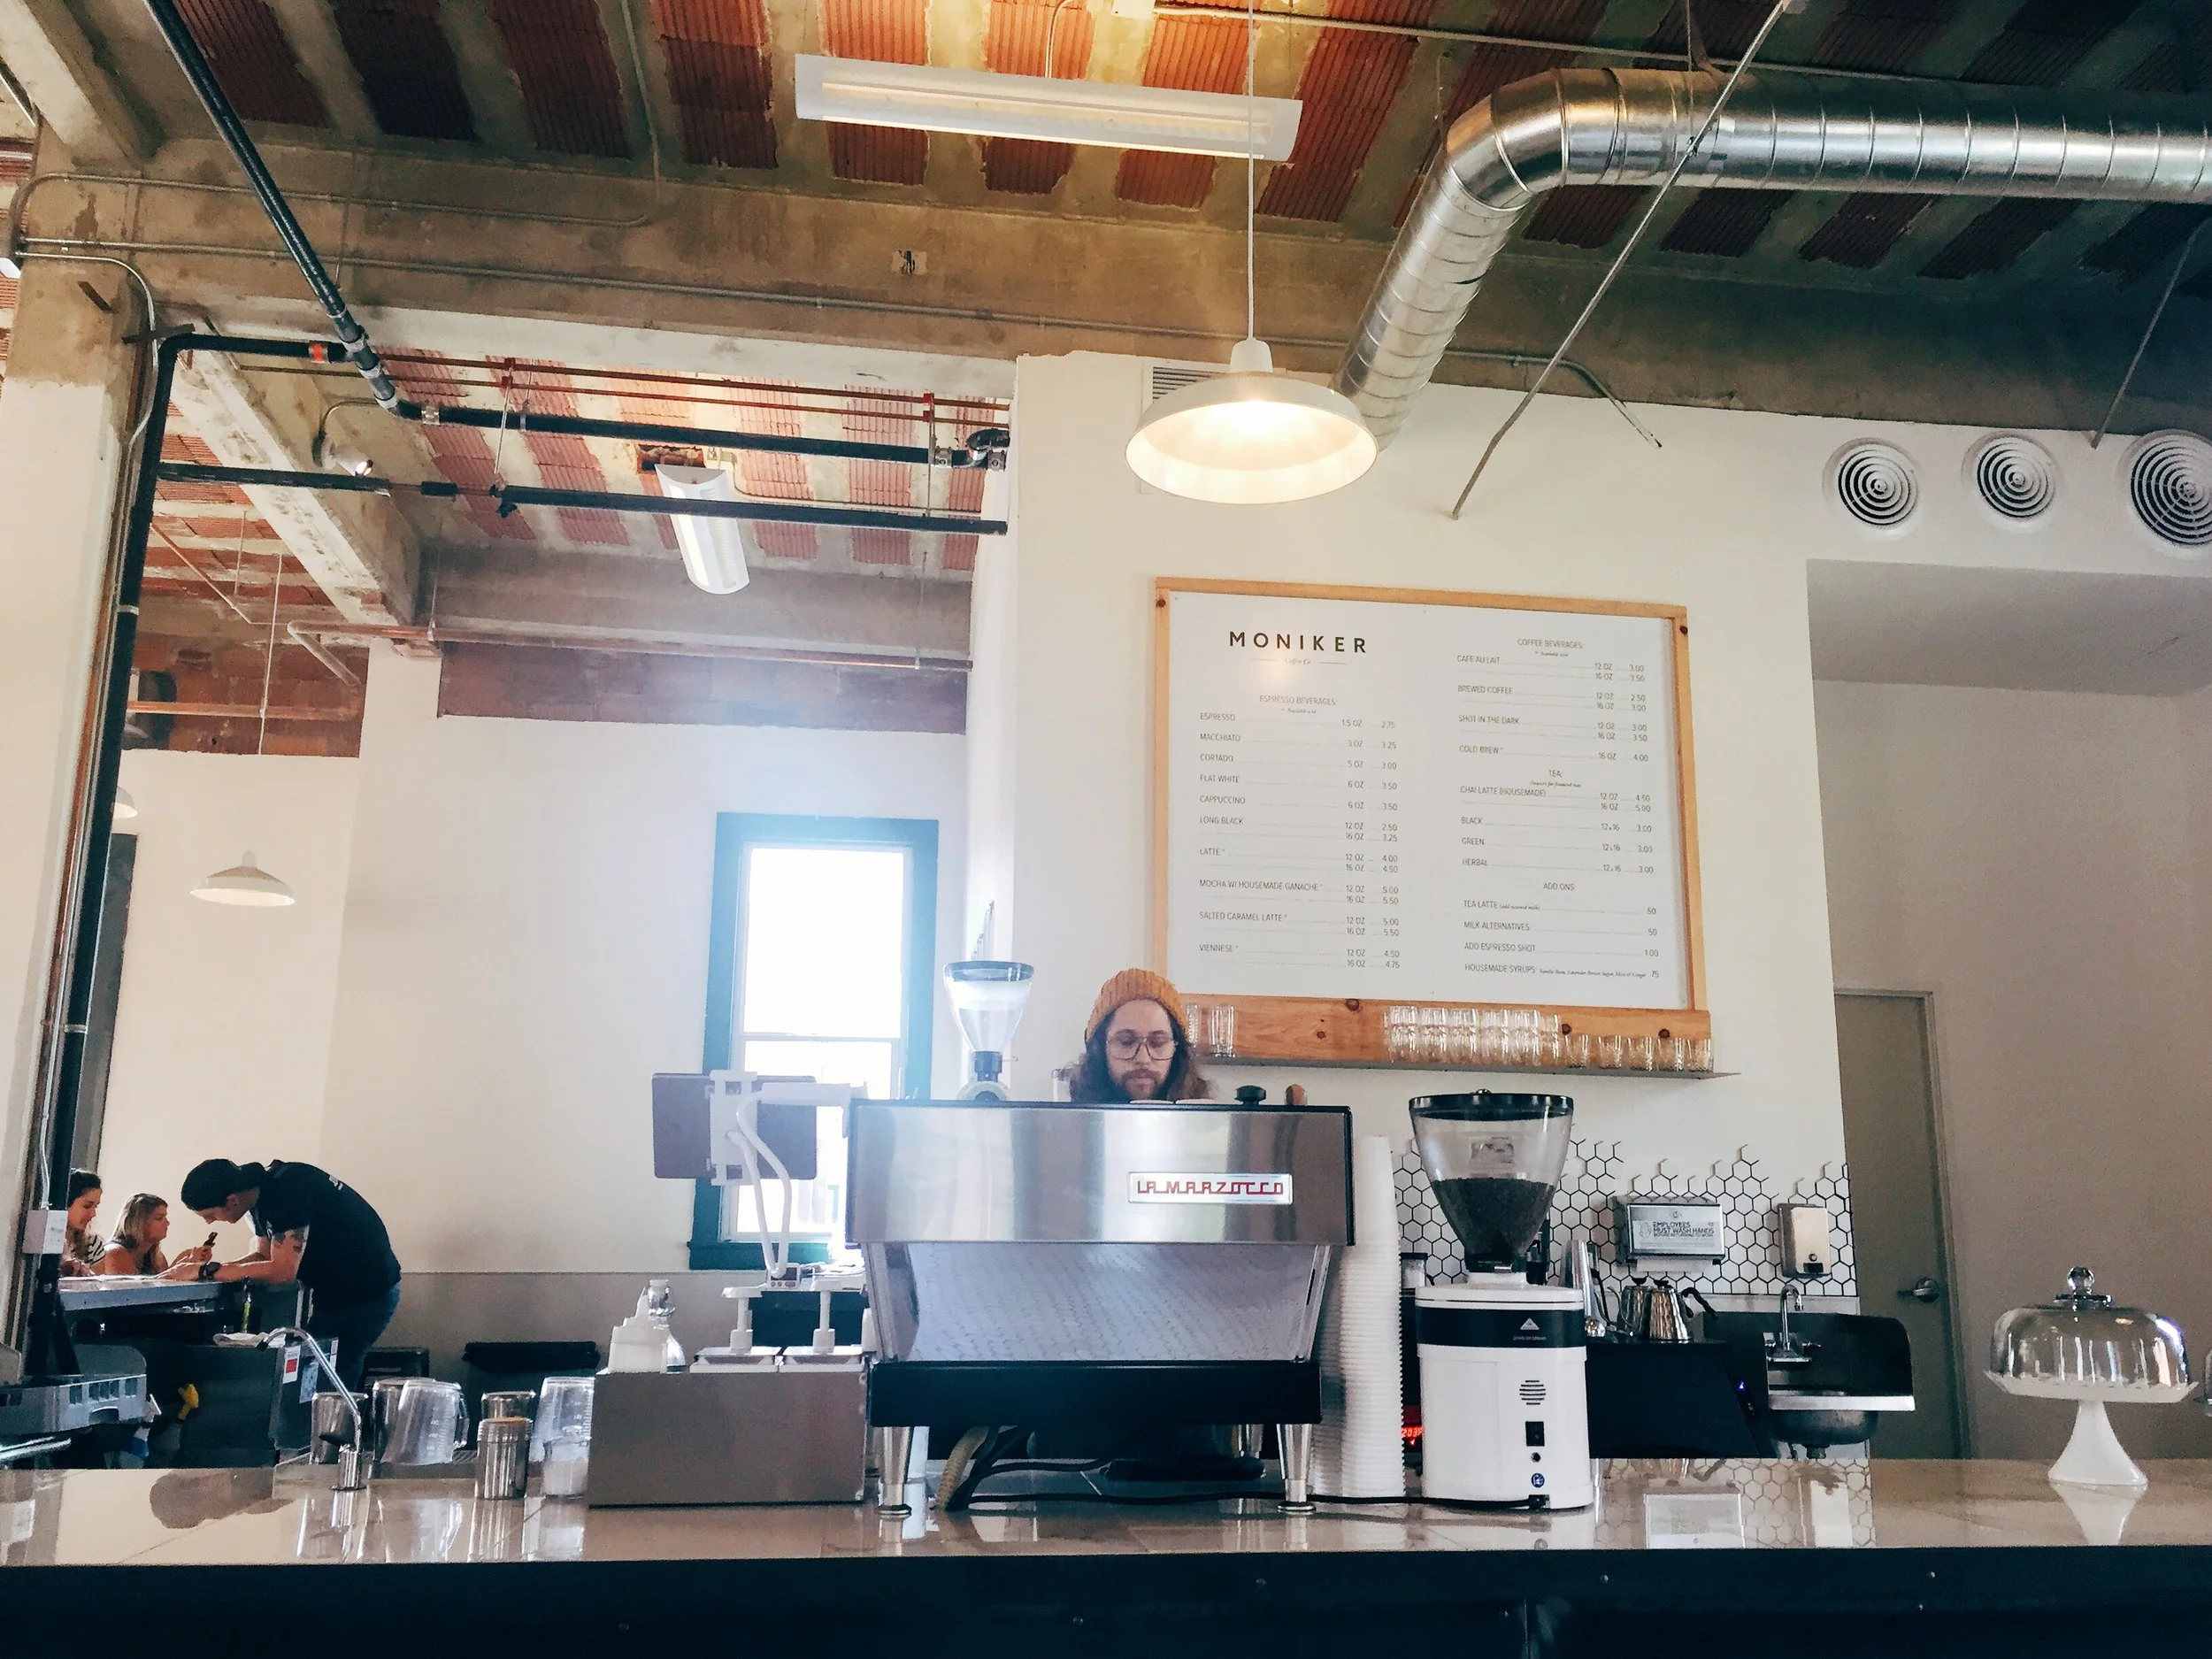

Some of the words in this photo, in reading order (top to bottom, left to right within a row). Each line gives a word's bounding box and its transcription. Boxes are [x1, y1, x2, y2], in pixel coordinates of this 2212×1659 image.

[1229, 632, 1366, 653] MONIKER
[1260, 695, 1294, 703] ESPRESSO
[1500, 787, 1547, 797] (HOUSEMADE)
[1200, 795, 1245, 804] CAPPUCCINO
[1200, 879, 1226, 888] MOCHA
[1227, 912, 1260, 921] CARAMEL
[1137, 1181, 1157, 1194] LA
[1165, 1181, 1284, 1194] MARZOCCO
